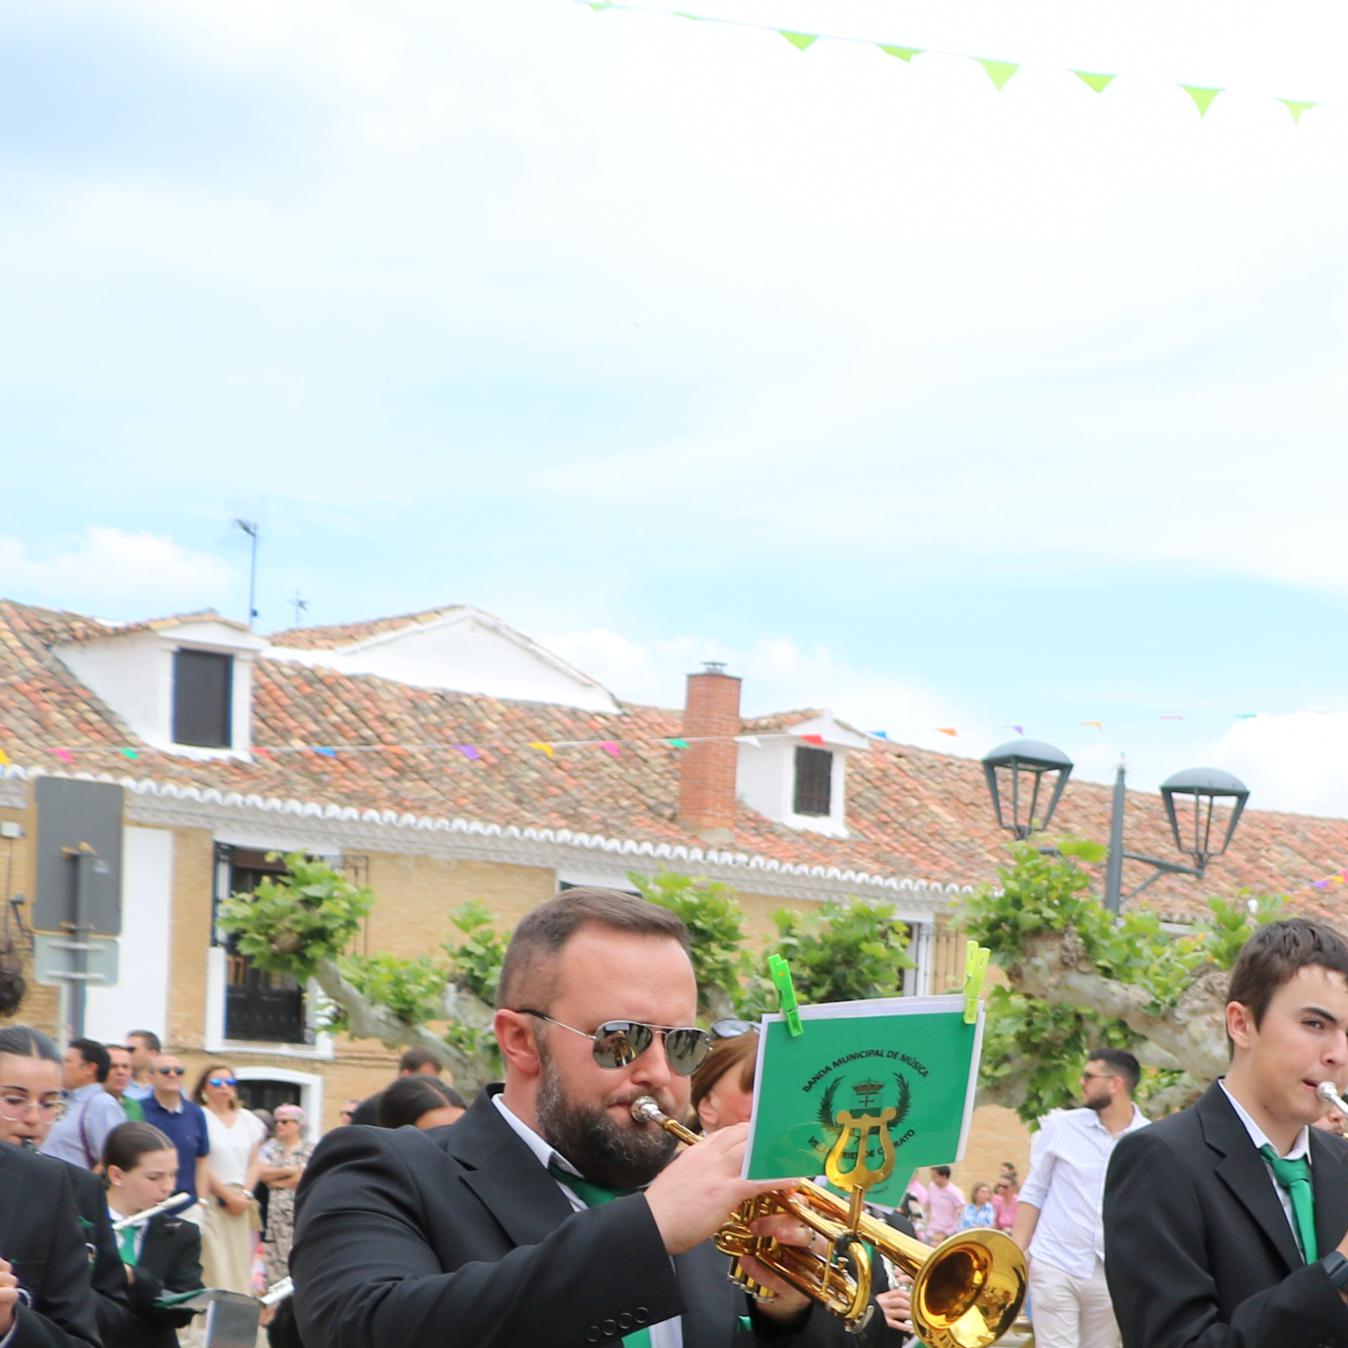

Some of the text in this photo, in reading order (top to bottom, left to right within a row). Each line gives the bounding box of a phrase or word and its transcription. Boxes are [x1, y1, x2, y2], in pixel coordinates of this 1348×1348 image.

[802, 1049, 929, 1093] BANDA MUNICIPAL DE MÚSICA
